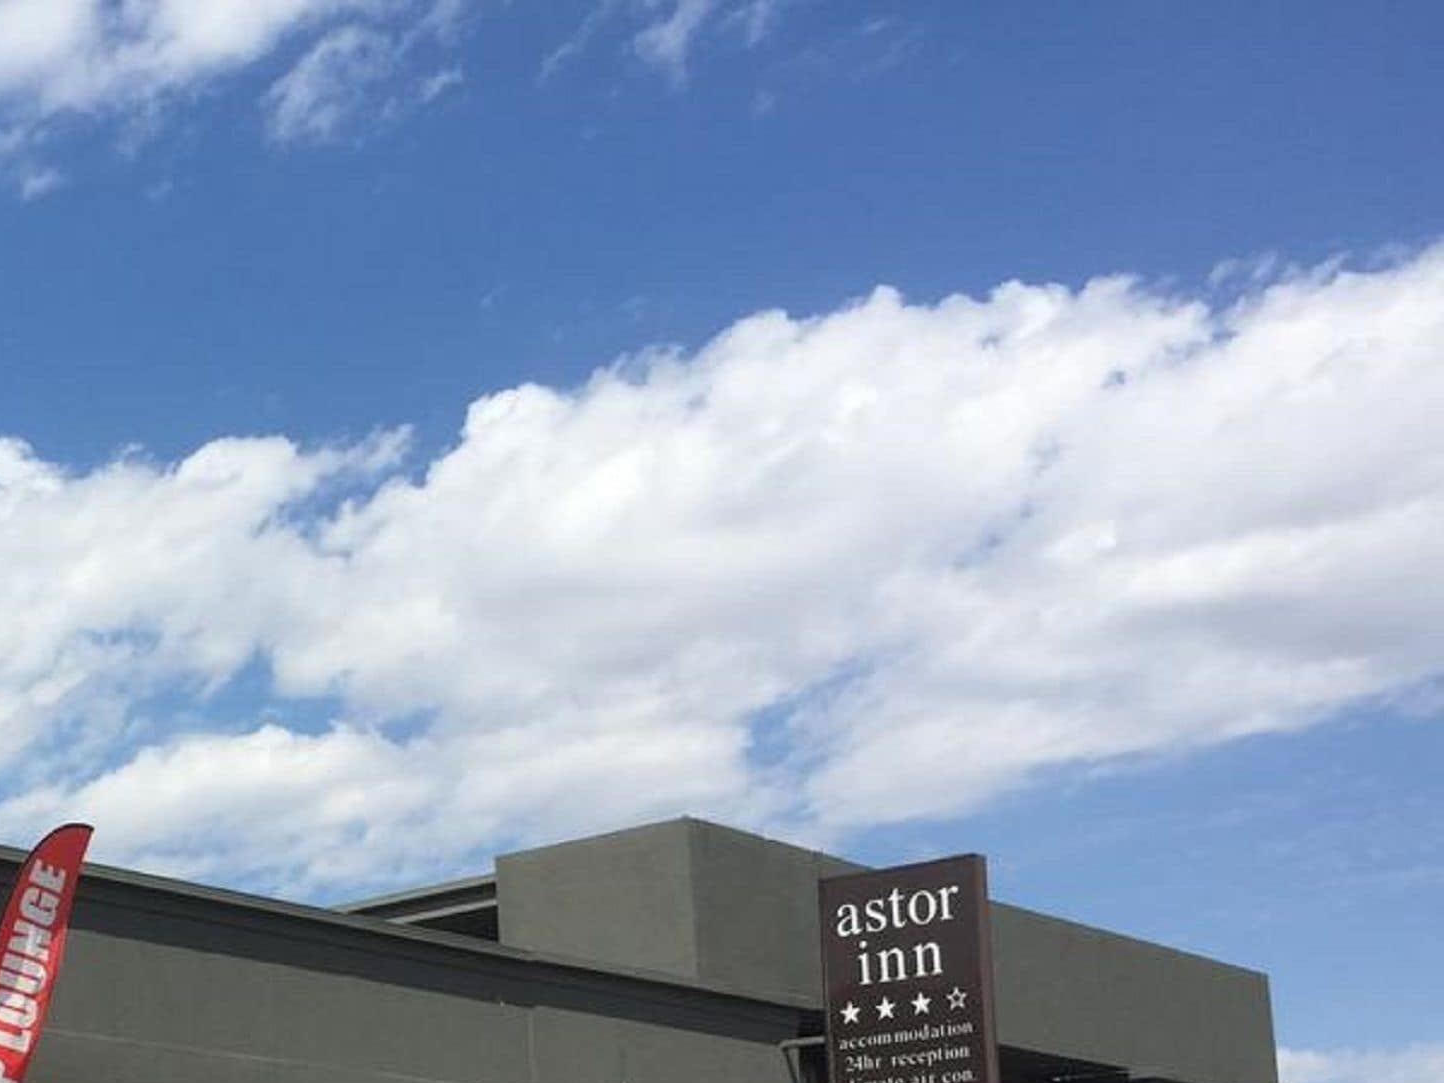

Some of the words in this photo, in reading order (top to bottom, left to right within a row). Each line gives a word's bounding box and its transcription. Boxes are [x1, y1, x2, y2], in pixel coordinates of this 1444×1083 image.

[837, 886, 959, 937] astor
[858, 940, 943, 985] inn
[839, 1020, 974, 1050] accommodation
[845, 1055, 882, 1072] 24hr
[891, 1045, 971, 1067] reception
